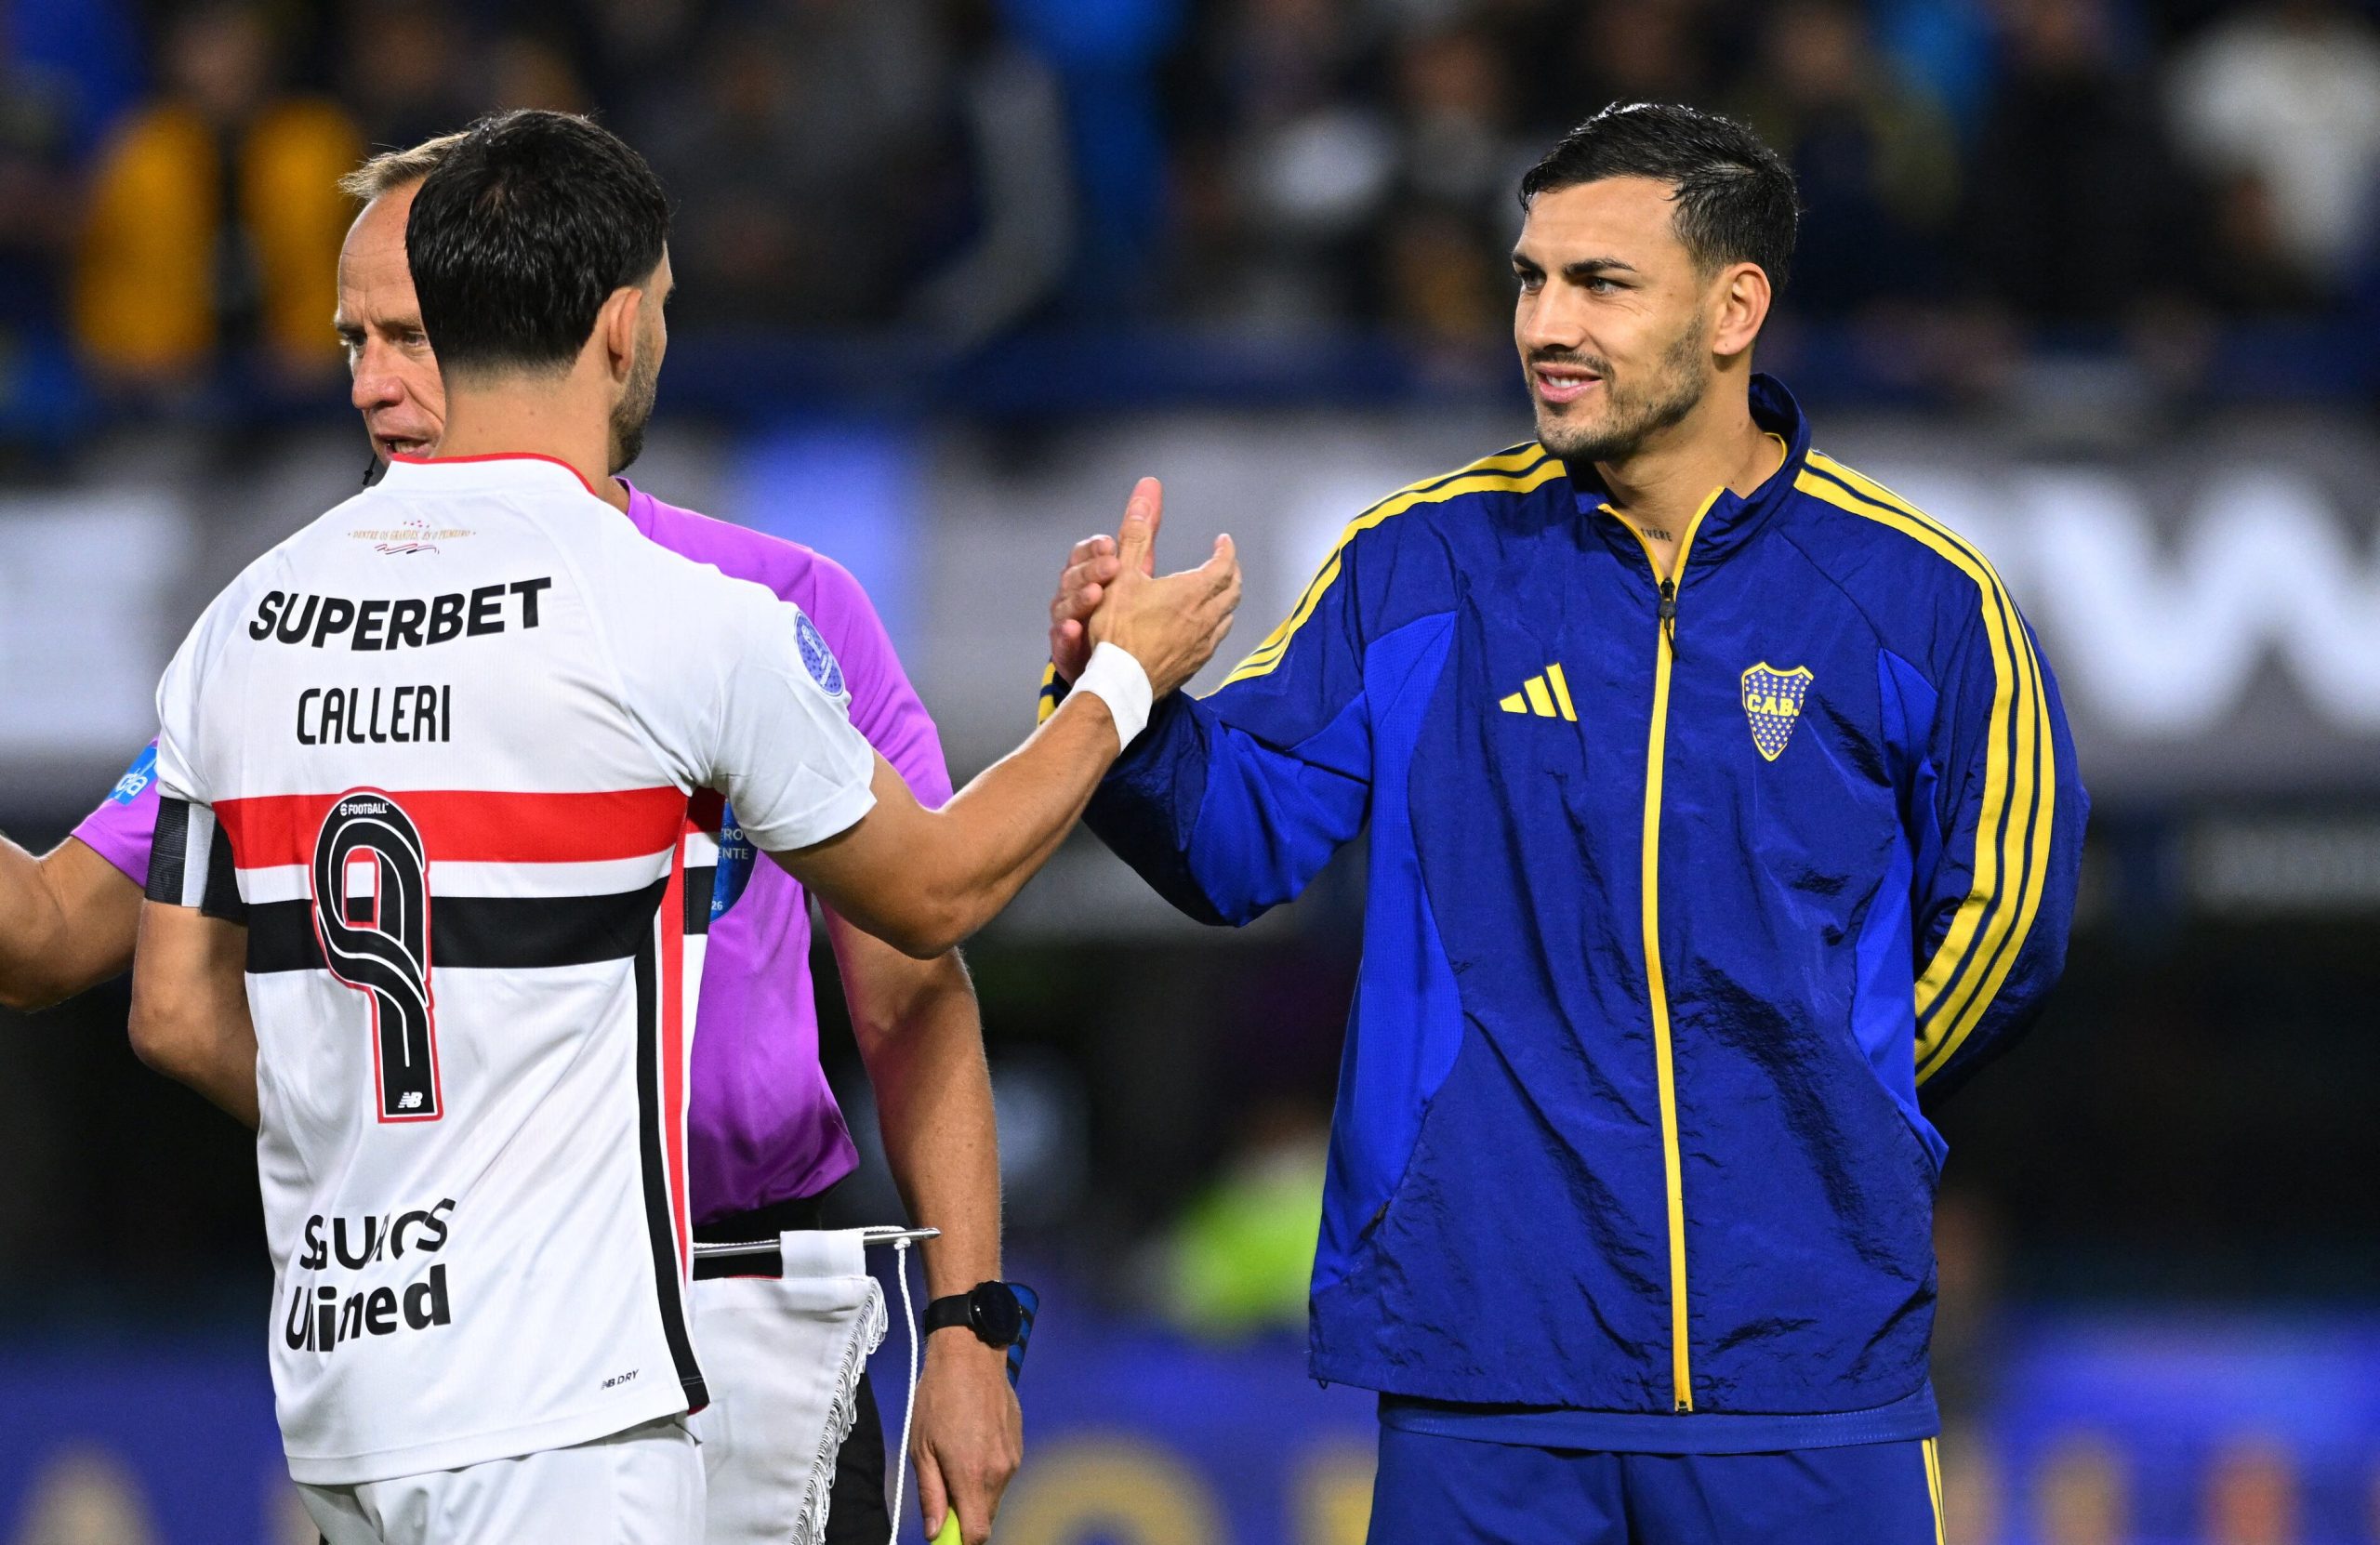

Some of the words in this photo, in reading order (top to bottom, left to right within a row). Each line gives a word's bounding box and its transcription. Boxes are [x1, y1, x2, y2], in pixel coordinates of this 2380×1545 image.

[248, 576, 551, 651] SUPERBET
[297, 684, 451, 745] CALLERI
[721, 827, 744, 840] RO
[718, 847, 749, 860] NTE
[310, 786, 443, 1123] 9
[617, 1368, 640, 1384] DRY
